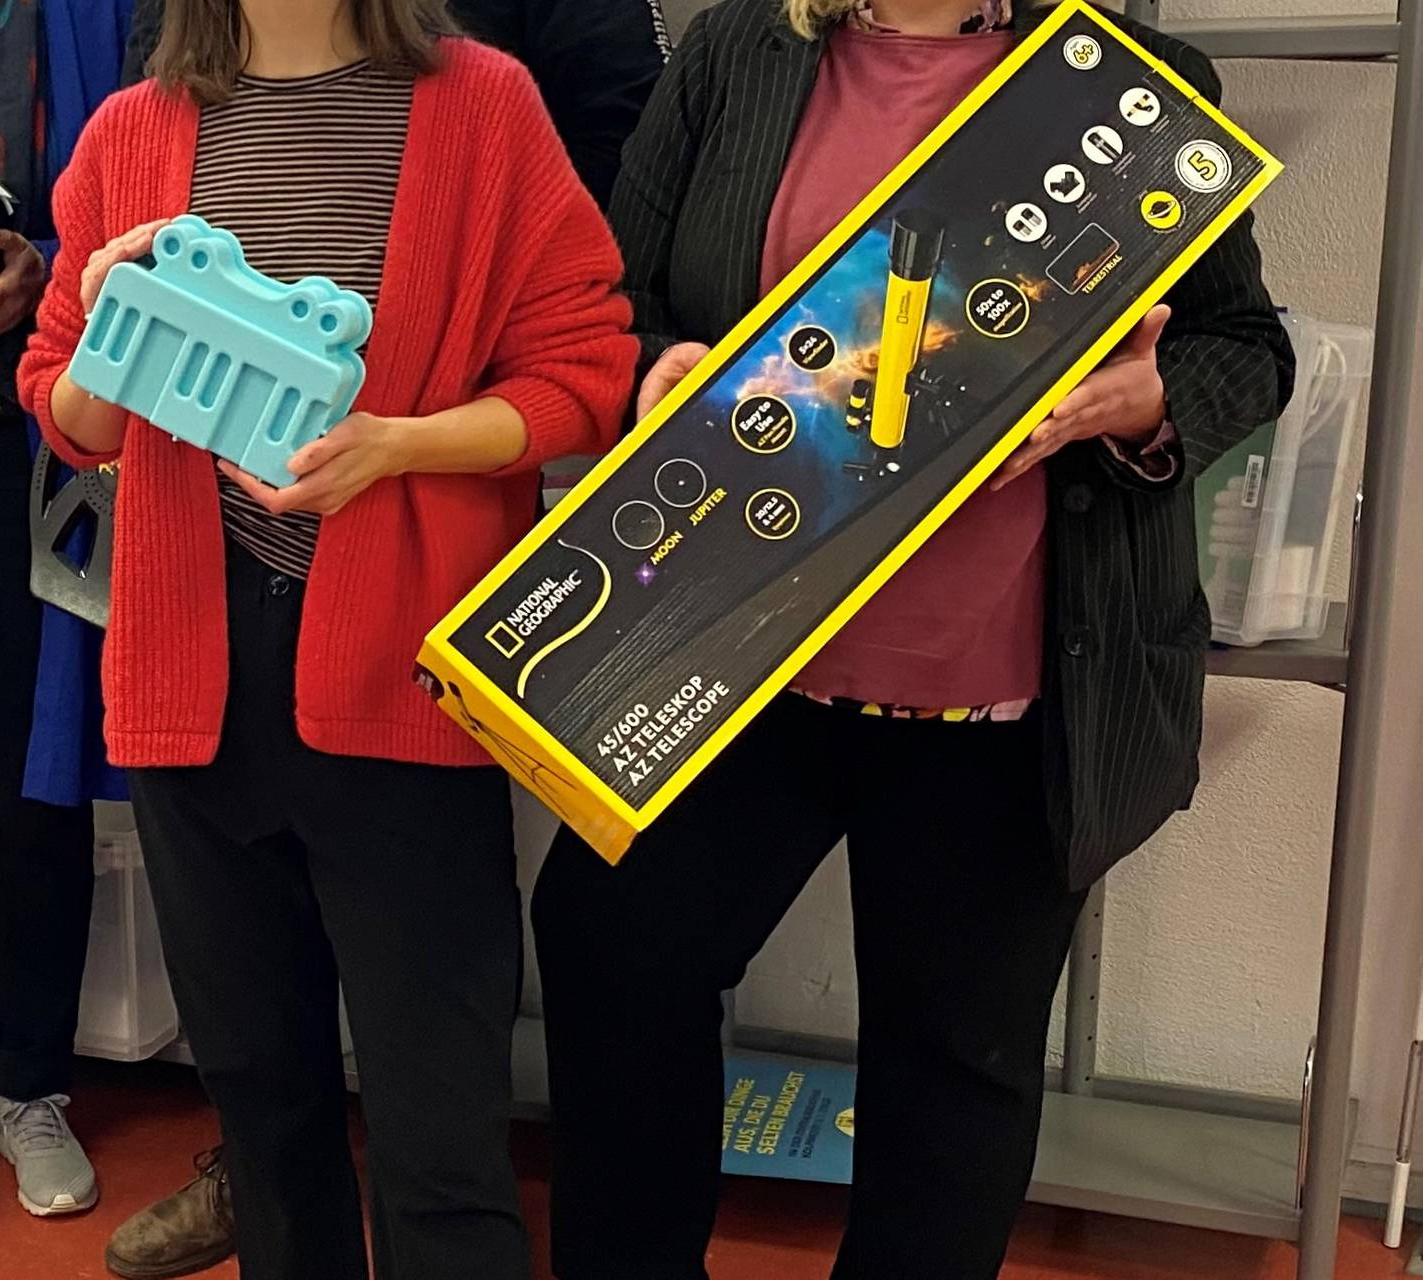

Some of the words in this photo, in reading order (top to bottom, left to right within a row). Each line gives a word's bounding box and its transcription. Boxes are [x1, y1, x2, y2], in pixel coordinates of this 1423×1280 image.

[1073, 43, 1094, 64] 6+
[1187, 150, 1218, 181] 5
[1082, 254, 1123, 294] TERRESTRIAL
[976, 297, 995, 317] 50x
[991, 289, 1004, 301] to
[987, 299, 1012, 321] 100x
[739, 410, 762, 431] Easy
[758, 401, 771, 413] to
[754, 415, 774, 432] Use
[689, 488, 727, 526] JUPITER
[650, 530, 684, 565] MOON
[507, 578, 559, 627] NATIONAL
[518, 569, 582, 636] GEOGRAPHIC
[597, 703, 649, 757] 45/600
[613, 744, 638, 773] AZ
[631, 675, 702, 748] TELESKOP
[628, 758, 653, 787] AZ
[647, 681, 730, 762] TELESCOPE
[751, 1095, 771, 1109] DU
[756, 1118, 786, 1155] SELTEN
[771, 1071, 806, 1117] BRAUCHST
